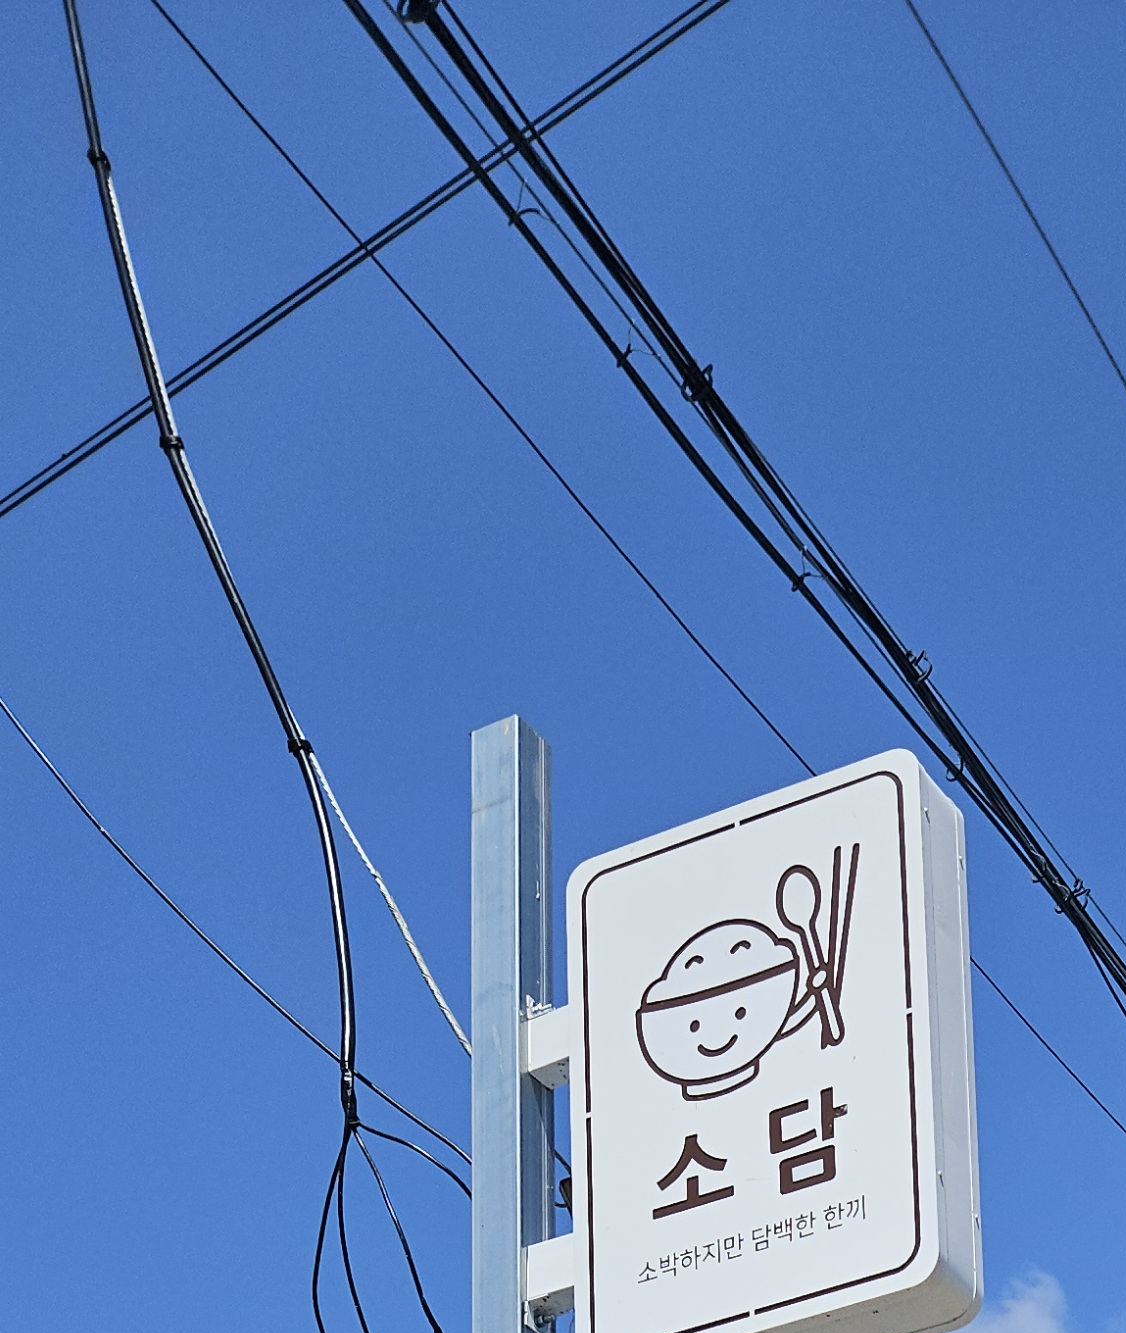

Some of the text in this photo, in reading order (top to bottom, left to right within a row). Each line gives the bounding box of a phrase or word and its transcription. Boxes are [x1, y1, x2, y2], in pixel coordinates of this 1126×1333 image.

[652, 1086, 848, 1220] 소담
[637, 1195, 867, 1284] 소박하지만 담백한 한끼
